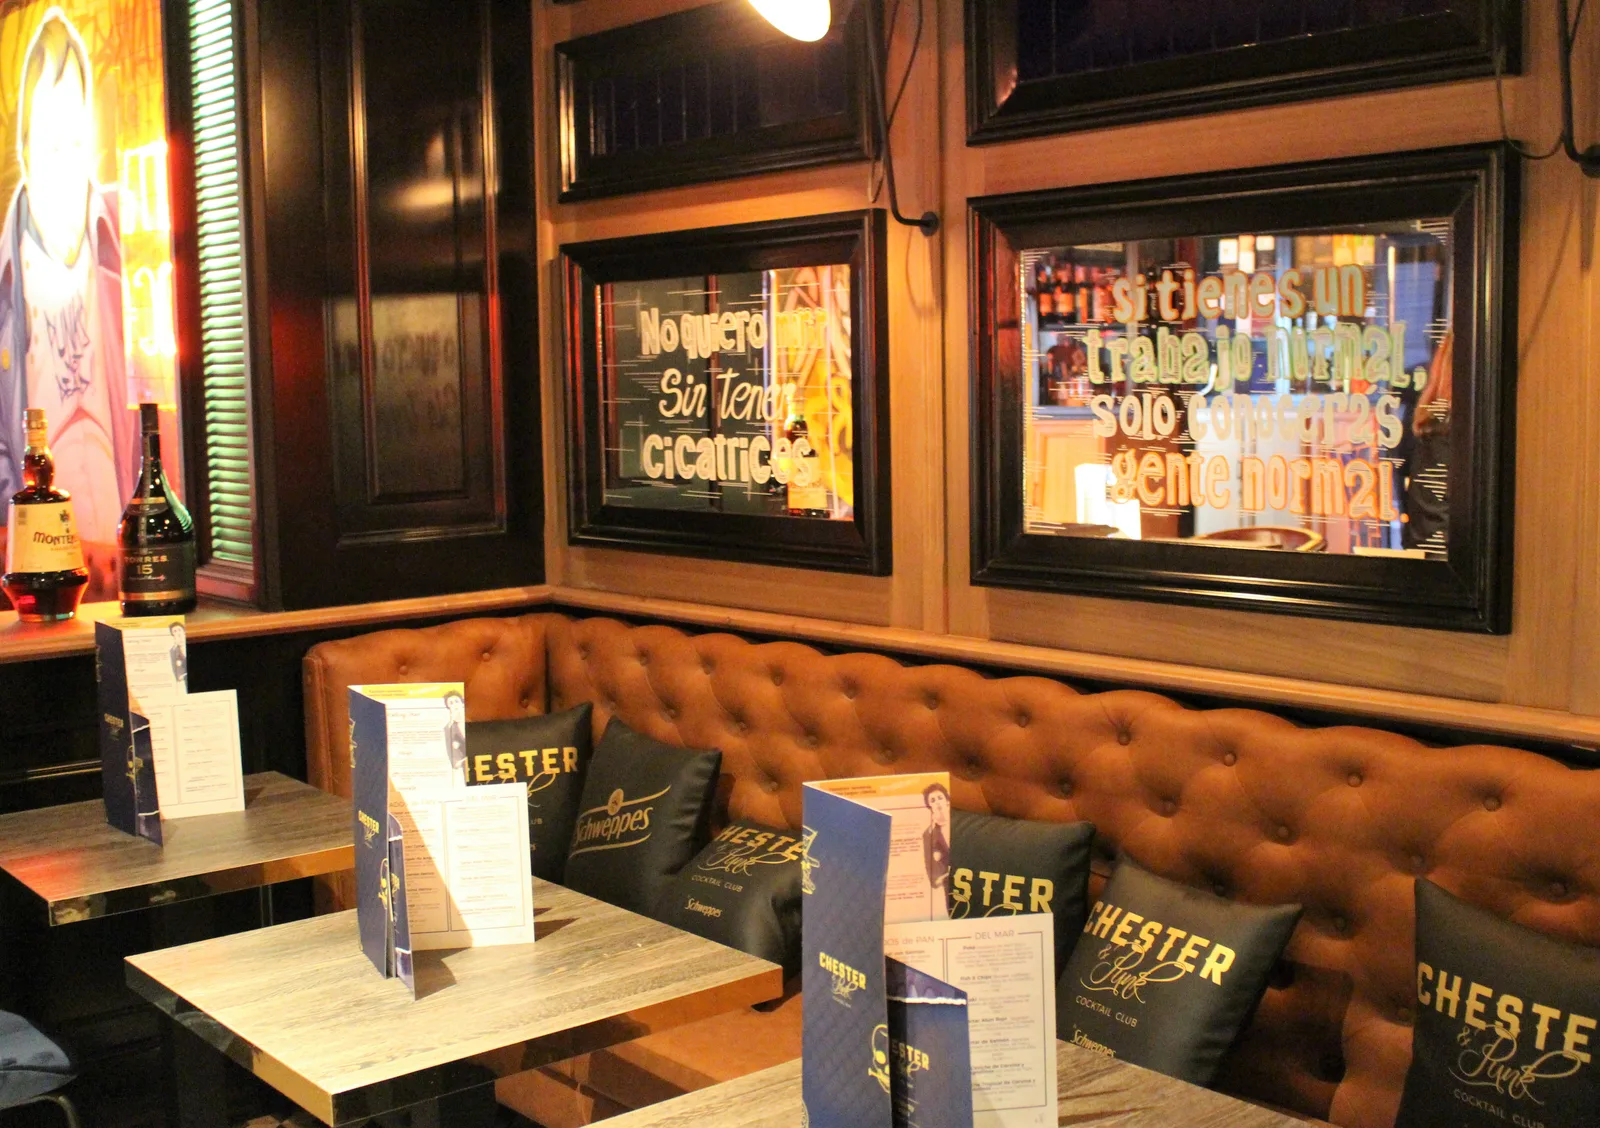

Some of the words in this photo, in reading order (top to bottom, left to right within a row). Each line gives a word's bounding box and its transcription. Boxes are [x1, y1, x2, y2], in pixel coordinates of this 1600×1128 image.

[1156, 268, 1305, 320] tienes
[1314, 263, 1366, 317] un
[640, 307, 680, 355] No
[680, 310, 768, 359] quiero
[1083, 324, 1253, 391] trabajo
[658, 368, 707, 418] Sin
[716, 368, 797, 421] tener
[1111, 448, 1231, 509] gente
[123, 555, 168, 564] TORRES
[136, 563, 153, 575] 15
[573, 806, 654, 847] Schweppes
[714, 825, 803, 860] HESTE
[691, 874, 721, 887] COCKTAIL
[724, 881, 744, 892] CLUB
[948, 867, 1053, 913] STER
[684, 898, 723, 918] Schweppes
[974, 931, 991, 940] DEL
[994, 930, 1015, 938] MAR
[1083, 900, 1236, 986] CHESTER
[819, 951, 867, 990] CHESTER
[1075, 995, 1113, 1017] COCKTAIL
[1115, 1012, 1138, 1028] CLUB
[1417, 961, 1597, 1064] CHESTE
[1453, 1088, 1506, 1120] COCKTAIL
